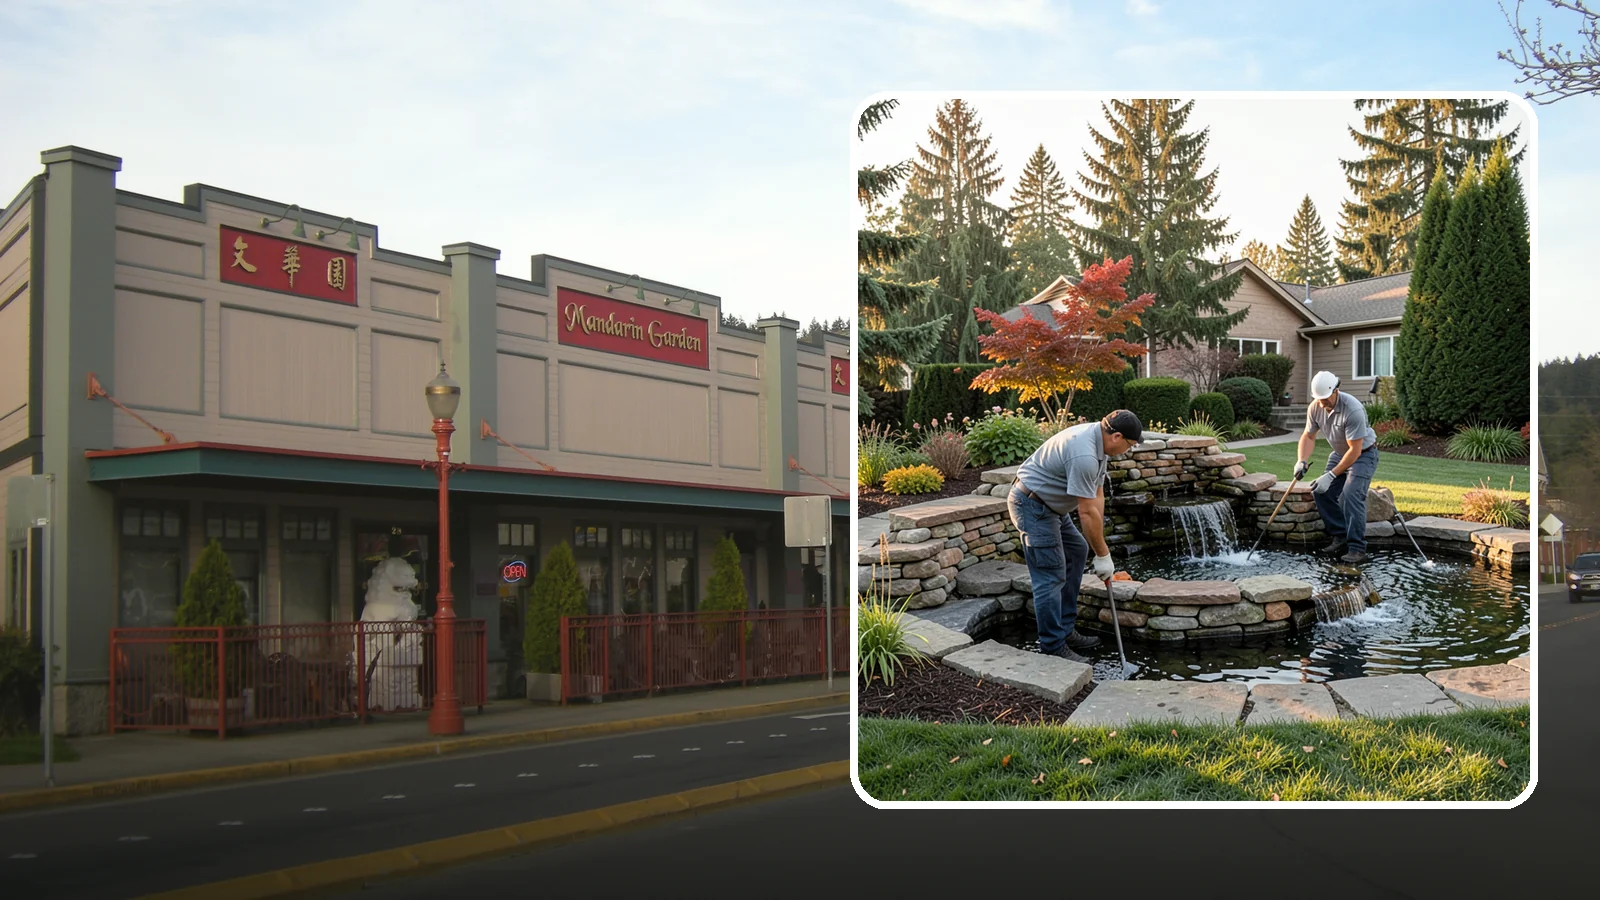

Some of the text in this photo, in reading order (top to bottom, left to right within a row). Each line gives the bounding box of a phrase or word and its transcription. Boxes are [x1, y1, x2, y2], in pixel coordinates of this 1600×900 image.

[564, 302, 702, 352] Mandarin Garden
[503, 565, 527, 578] OPEN
